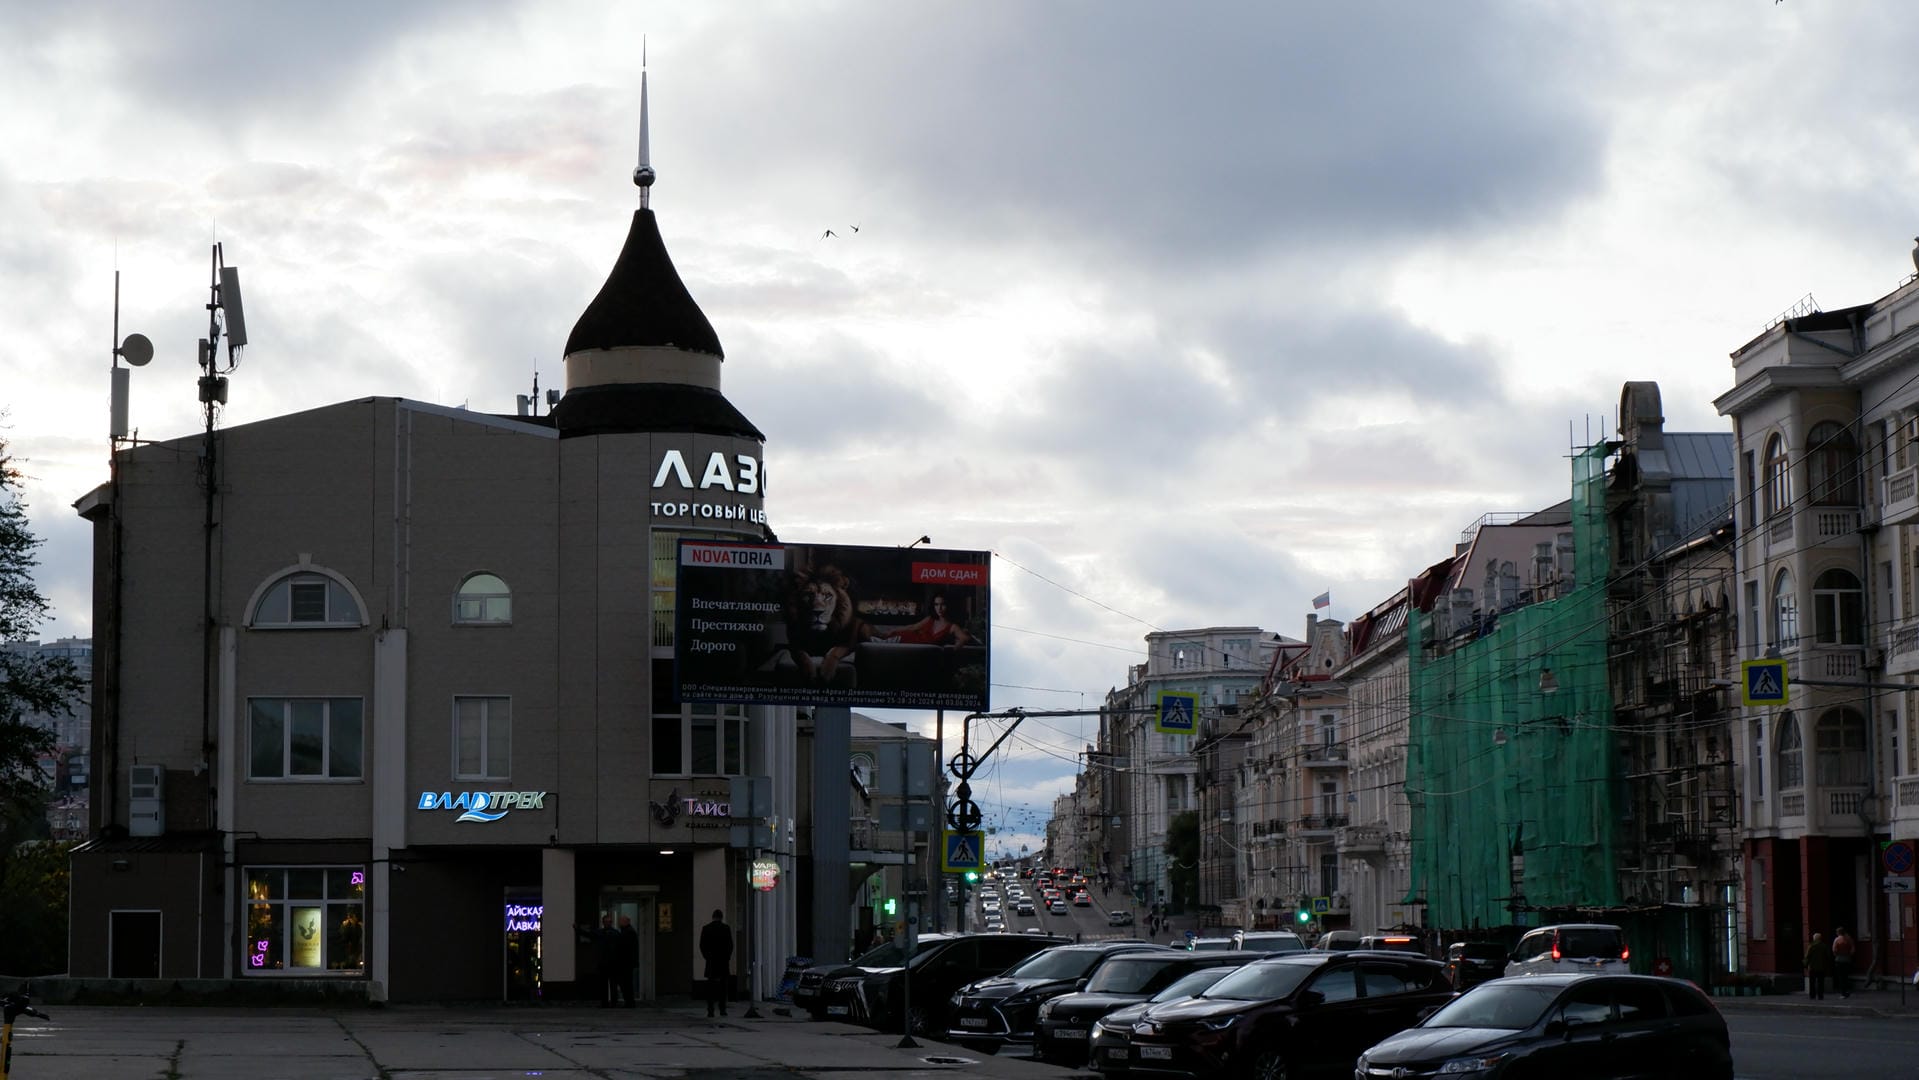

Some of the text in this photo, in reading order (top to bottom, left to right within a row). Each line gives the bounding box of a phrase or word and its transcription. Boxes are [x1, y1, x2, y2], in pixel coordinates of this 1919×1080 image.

[652, 449, 767, 496] ЛАЗ
[651, 502, 746, 521] ТОРГОВЫЙ
[692, 549, 773, 566] NOVATORIA
[920, 568, 978, 581] ДОМ СДАН
[691, 598, 781, 614] Впечатляюще
[691, 617, 765, 633] Престижно
[690, 639, 736, 654] Дорого
[683, 798, 730, 817] ТАЙС
[507, 919, 539, 931] ЛАВКА
